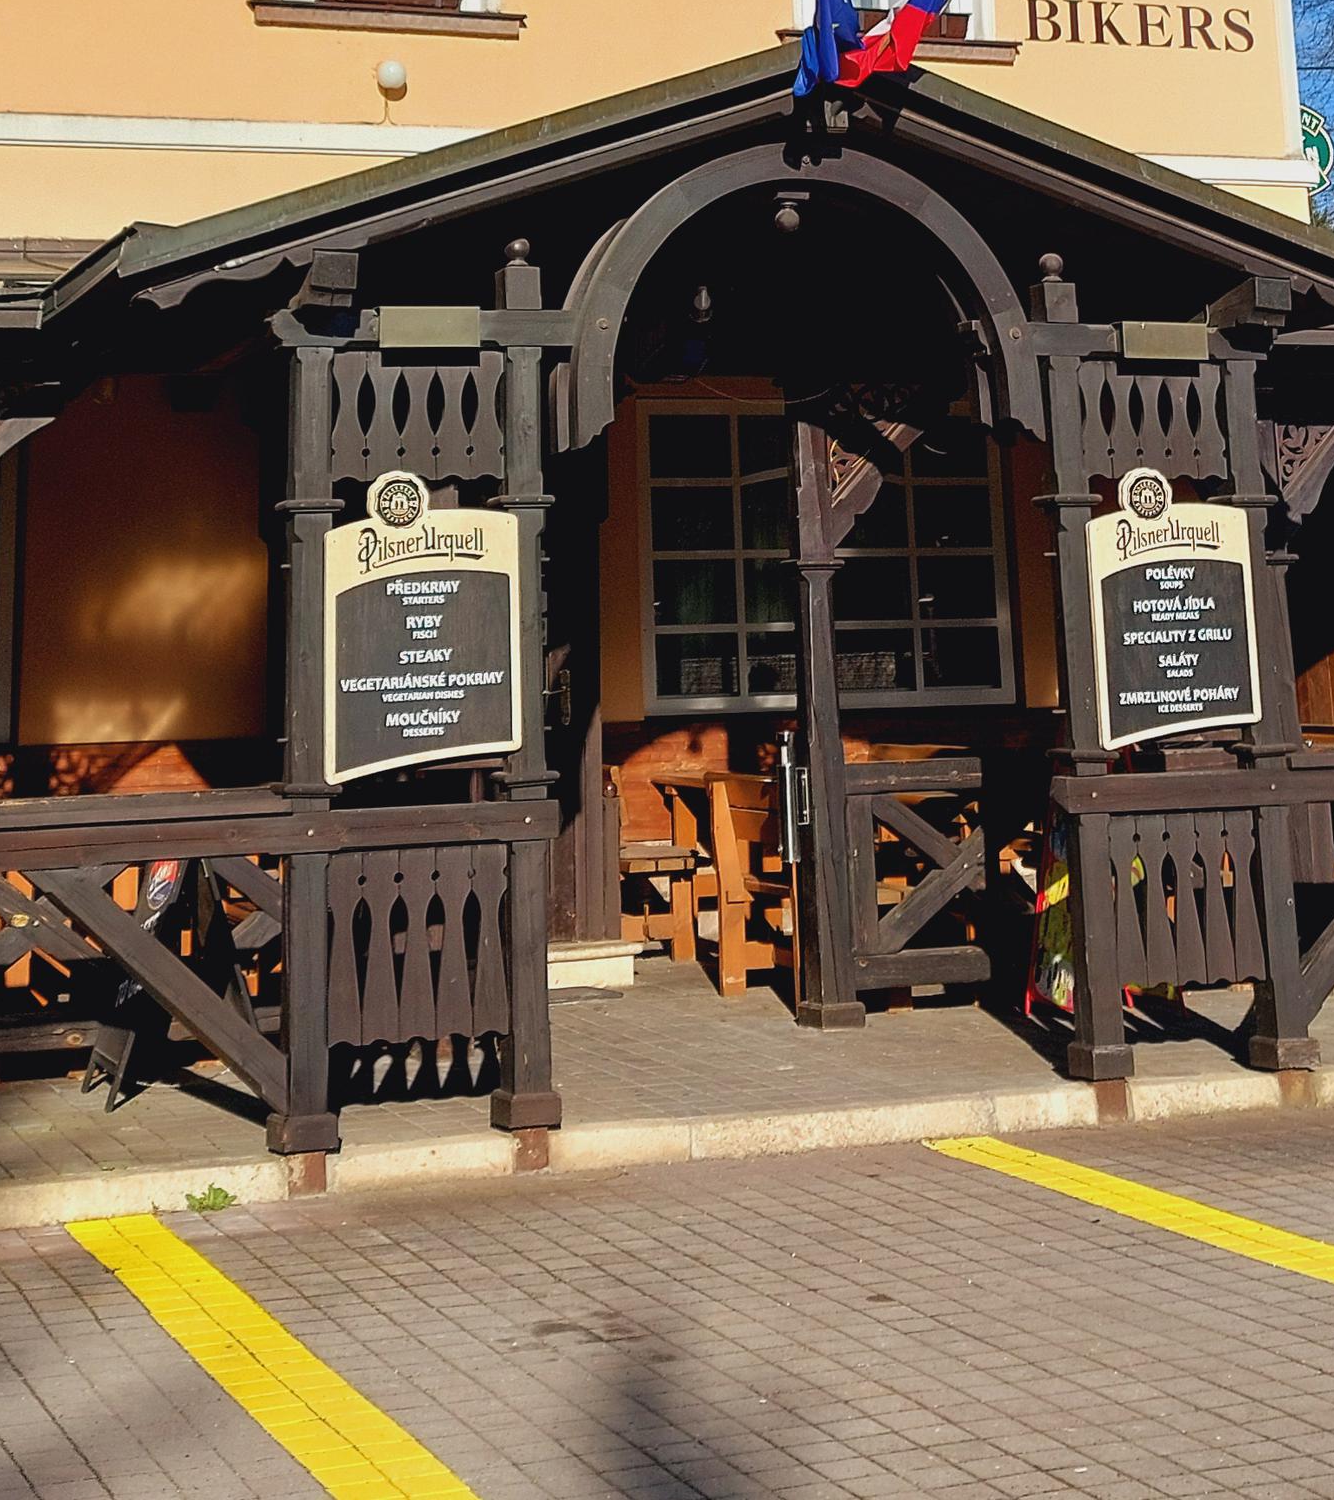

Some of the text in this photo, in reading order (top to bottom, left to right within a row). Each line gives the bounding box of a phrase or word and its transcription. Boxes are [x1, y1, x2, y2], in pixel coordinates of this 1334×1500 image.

[1116, 517, 1220, 561] Pilsner Urquell
[357, 523, 486, 575] Pilsner Urquell
[1145, 564, 1195, 580] POLÉVKY
[386, 579, 460, 595] PŘEDKRMY
[1159, 580, 1184, 590] SOUPS
[401, 595, 445, 605] STARTERS
[1133, 595, 1215, 613] HOTOVÁ JÍDLA
[405, 615, 443, 629] RYBY
[1151, 611, 1200, 622] READY MEALS
[412, 630, 437, 639] FISCH
[1123, 628, 1232, 645] SPECIALITY Z GRILU
[398, 649, 453, 664] STEAKY
[1158, 651, 1199, 667] SALÁTY
[1166, 668, 1193, 678] SALADS
[340, 671, 504, 692] VEGETARIÁNSKÉ POKRMY
[382, 690, 465, 702] VEGETARIAN DISHES
[1119, 685, 1239, 705] ZMRZLINOVÉ POHÁRY
[1157, 702, 1203, 713] ICE DESSERTS
[385, 708, 461, 727] MOUČNÍKY
[402, 727, 445, 737] DESSERTS
